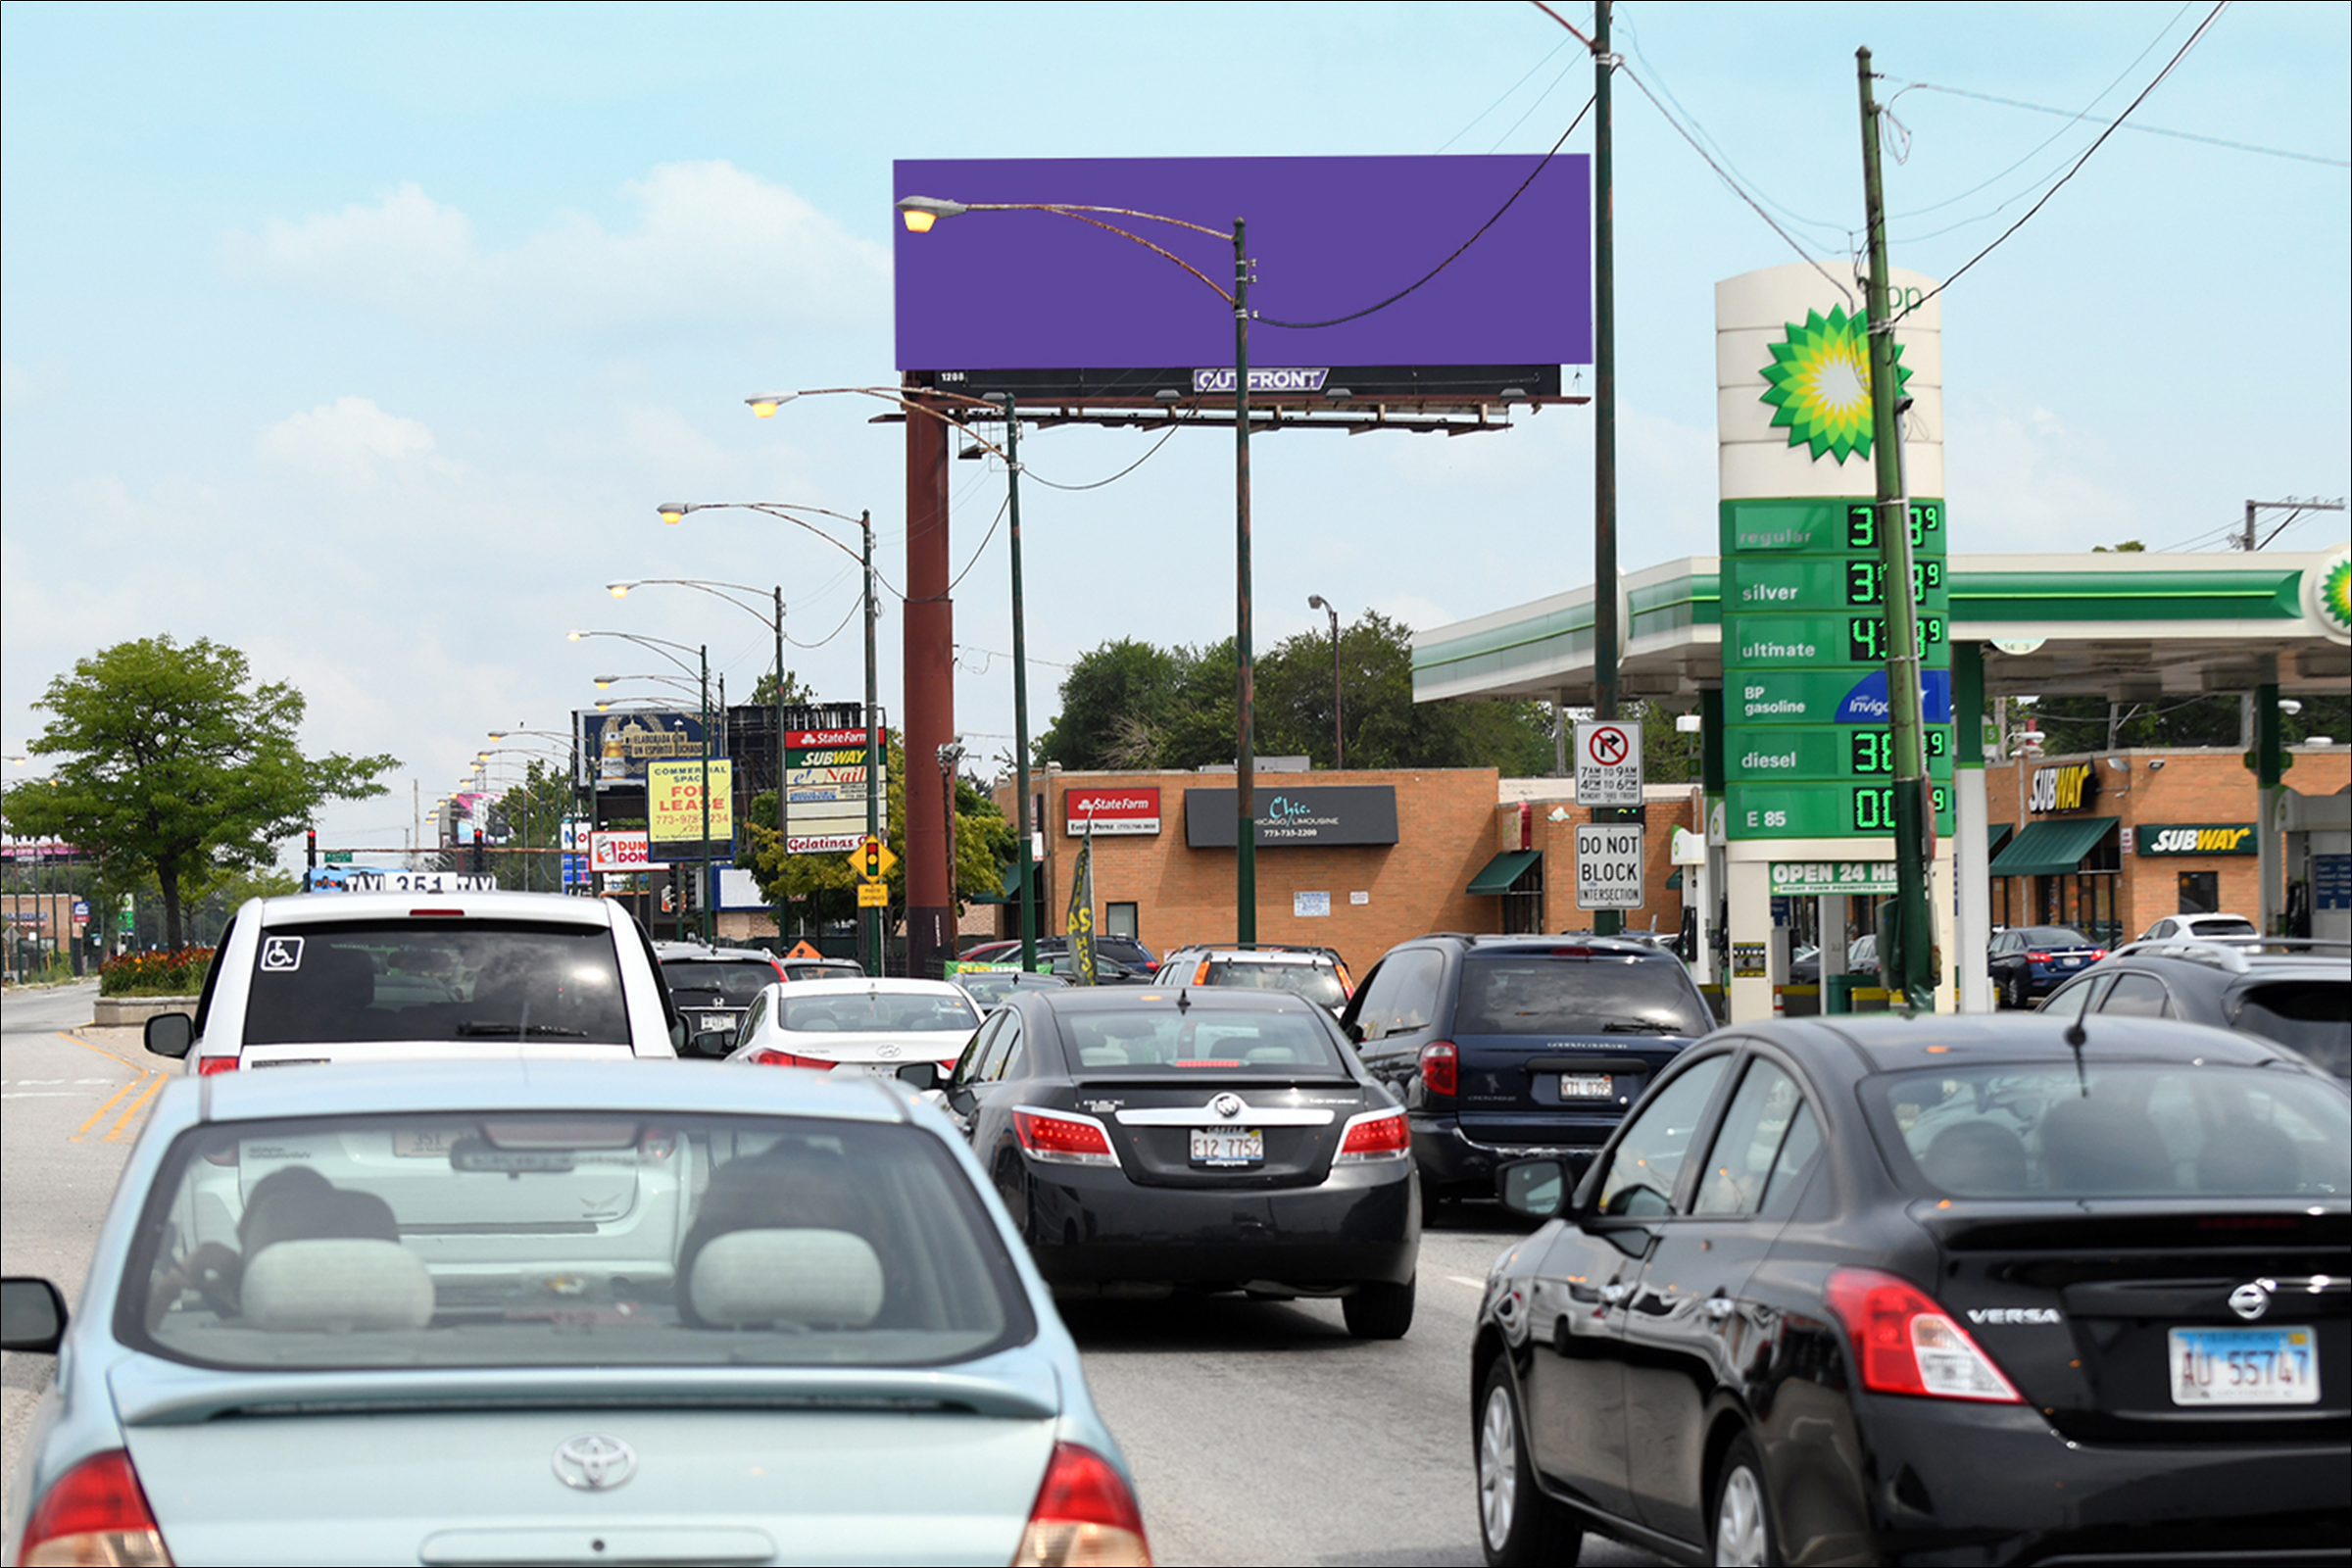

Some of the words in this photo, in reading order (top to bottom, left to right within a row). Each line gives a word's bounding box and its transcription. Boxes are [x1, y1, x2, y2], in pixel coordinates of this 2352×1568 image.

[1740, 528, 1812, 547] regular
[1742, 584, 1798, 601] silver
[1742, 642, 1816, 658] ultimate
[1744, 687, 1765, 700] BP
[1744, 701, 1806, 716] gasoline
[1987, 728, 1995, 740] 5
[801, 750, 867, 766] SUBWAY
[1740, 752, 1796, 768] diesel
[654, 766, 727, 775] COMMERIAL
[824, 766, 866, 782] Nail
[1603, 767, 1615, 776] TO
[1603, 780, 1615, 789] TO
[2029, 763, 2089, 812] SUBWAY
[656, 813, 729, 825] 773-978-234
[1292, 816, 1340, 825] LIMOUSINE
[1746, 810, 1758, 827] E
[1763, 810, 1787, 827] 85
[617, 841, 648, 852] DUN
[788, 836, 854, 852] Gelatinas
[1580, 837, 1601, 855] DO
[1607, 836, 1638, 855] NOT
[2151, 827, 2251, 852] SUBWAY
[617, 853, 648, 863] DON
[1582, 863, 1638, 881] BLOCK
[1772, 863, 1834, 883] OPEN
[1838, 863, 1866, 882] 24
[1871, 862, 1897, 882] HR
[1580, 889, 1640, 901] INTERSECTION
[1193, 1138, 1219, 1157] E12
[1226, 1138, 1261, 1157] 7752
[1967, 1308, 2060, 1324] VERSA
[2182, 1351, 2212, 1386] AU
[2228, 1350, 2308, 1386] 55747
